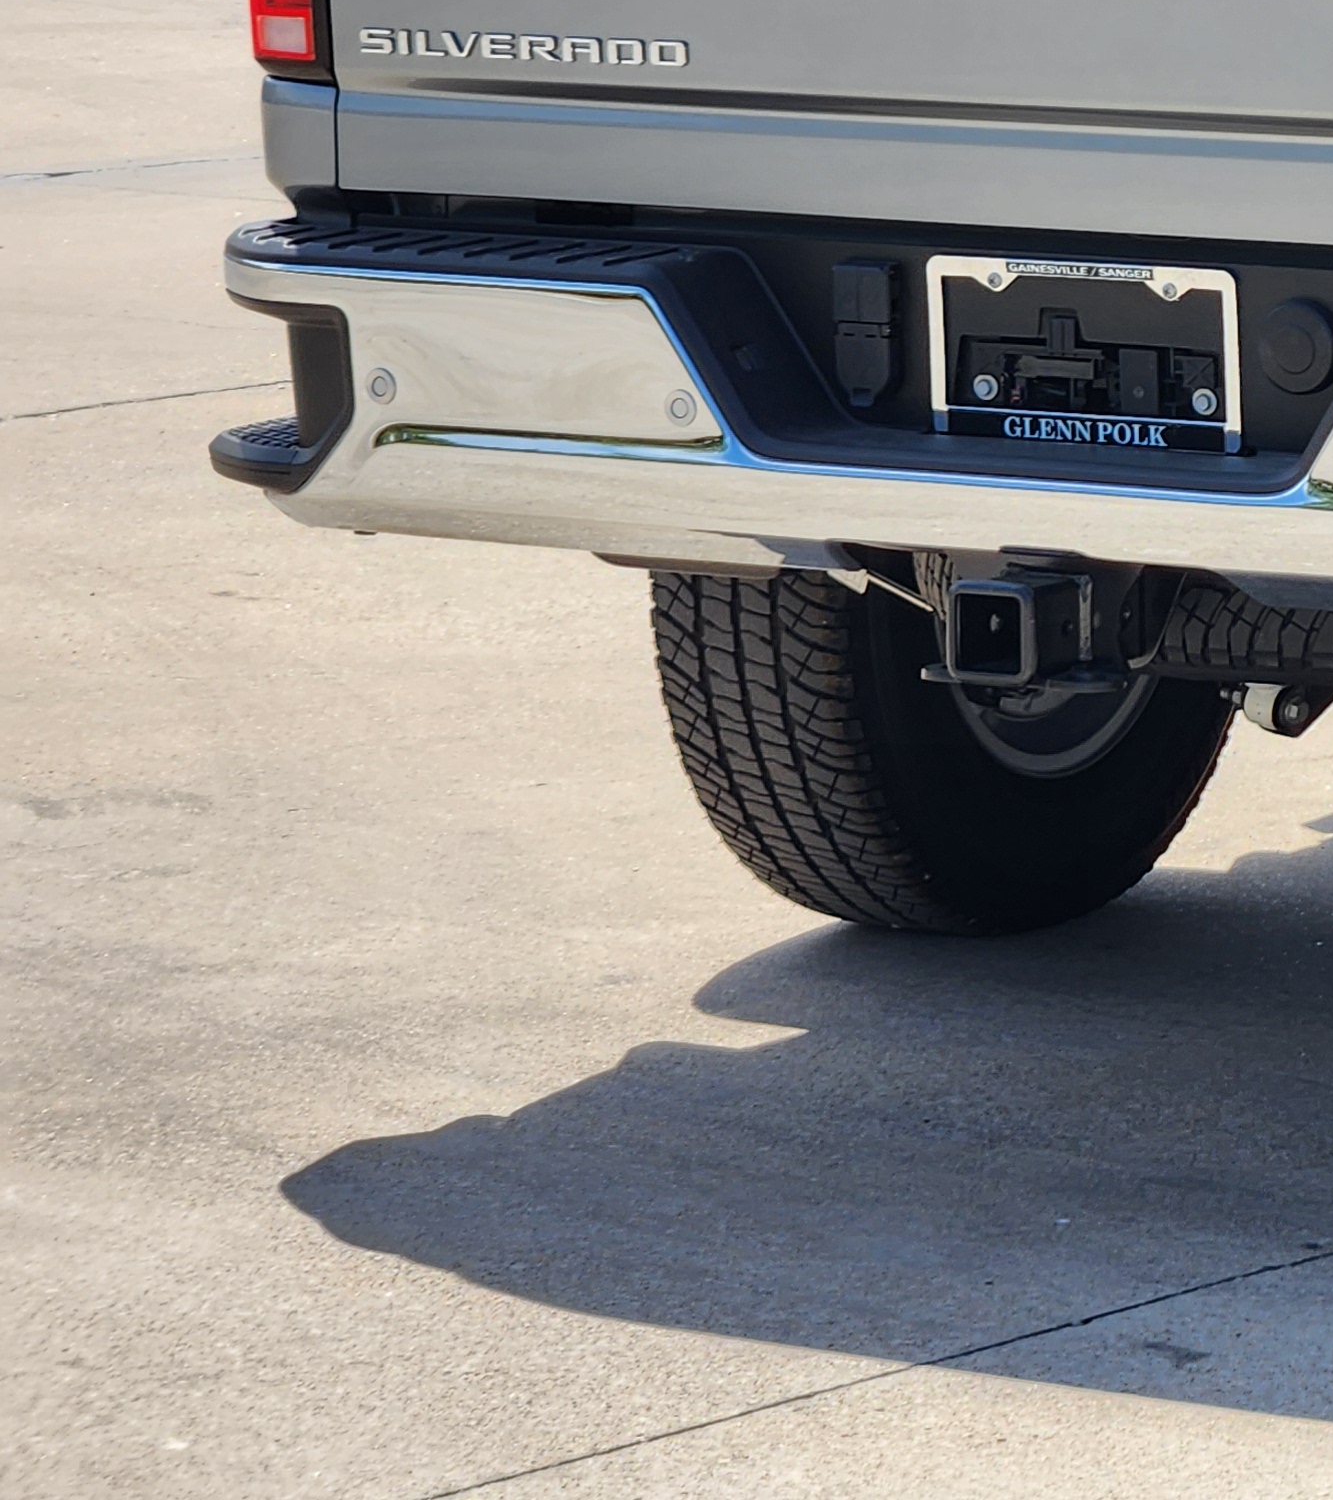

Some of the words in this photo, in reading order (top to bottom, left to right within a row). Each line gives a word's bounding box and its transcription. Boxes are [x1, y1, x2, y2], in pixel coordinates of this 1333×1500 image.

[359, 26, 690, 67] SILVERADO
[1008, 263, 1088, 276] GAINESVILLE
[1098, 268, 1151, 279] SANGER
[1003, 415, 1092, 443] GLENN
[1096, 420, 1169, 448] POLK
